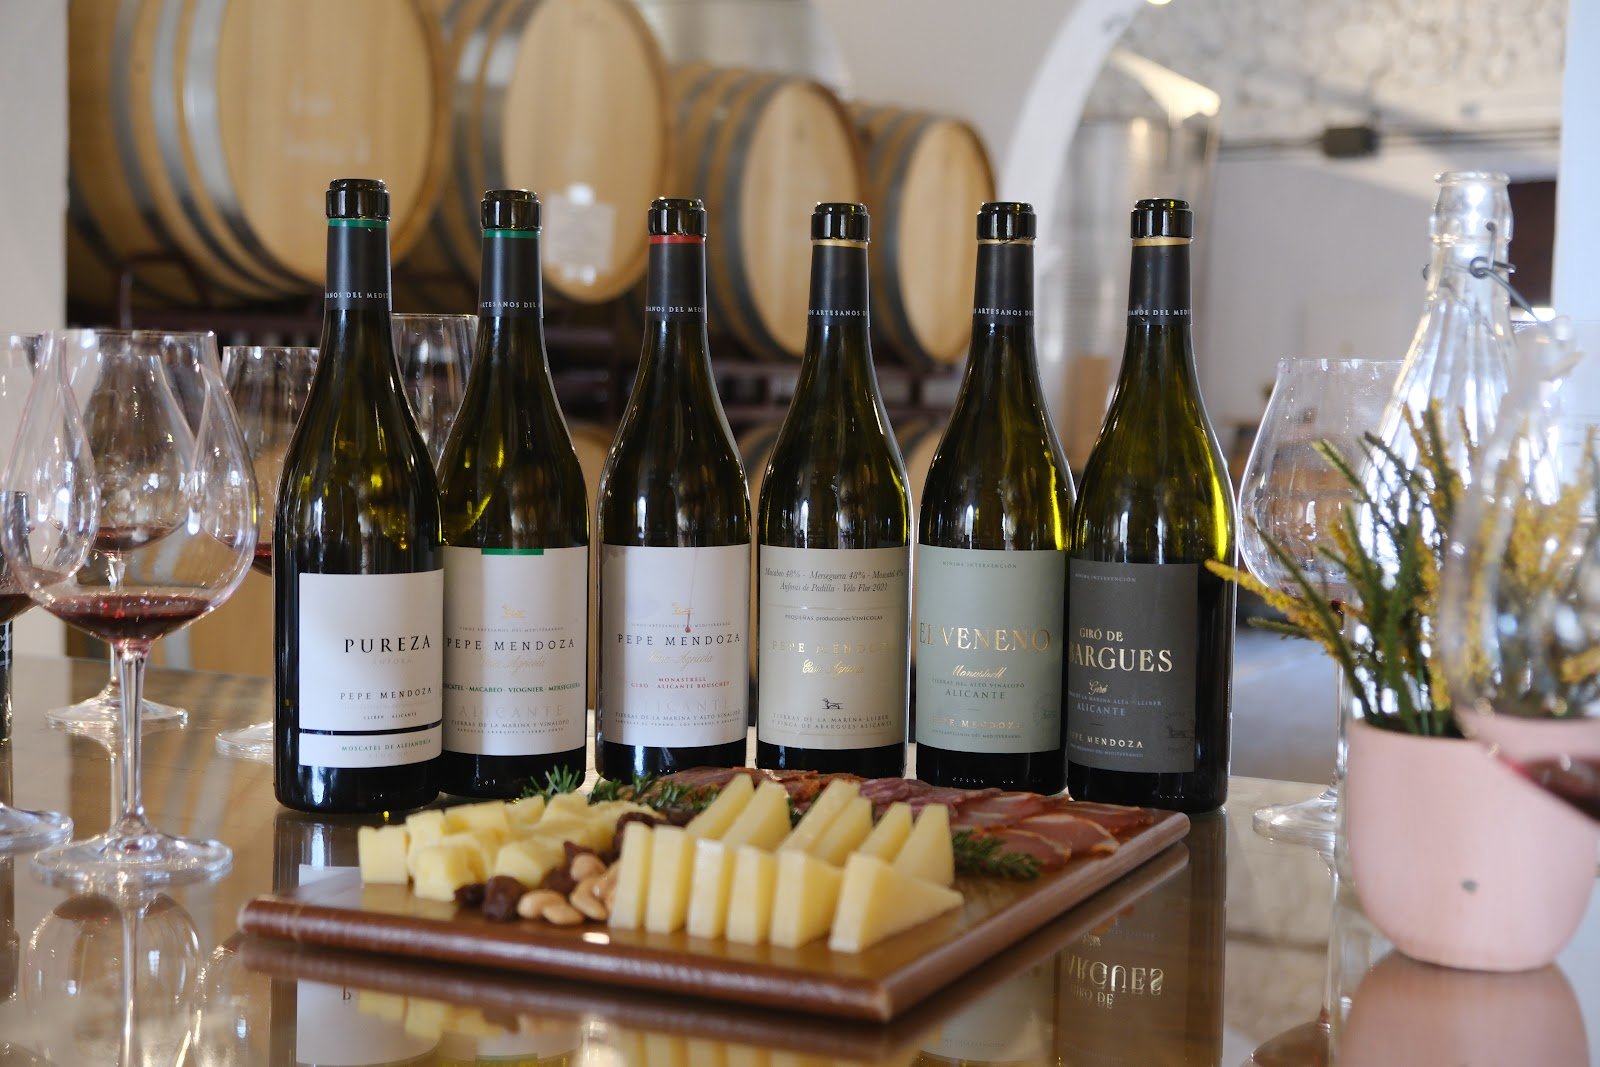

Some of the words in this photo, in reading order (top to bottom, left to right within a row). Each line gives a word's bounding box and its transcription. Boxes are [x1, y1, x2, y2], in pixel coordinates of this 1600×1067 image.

[815, 309, 861, 317] ARTESANOS
[977, 307, 1022, 316] ARTESANOS
[809, 570, 846, 581] Merseguera
[848, 571, 866, 580] 48%
[810, 583, 835, 592] Padilla
[617, 634, 654, 646] PEPE
[664, 633, 741, 647] MENDOZA
[919, 622, 935, 646] EL
[940, 625, 1051, 652] VENENO
[1079, 627, 1103, 641] GIRÓ
[1106, 630, 1124, 642] DE
[344, 634, 432, 654] PUREZA
[446, 637, 482, 650] PEPE
[494, 638, 575, 651] MENDOZA
[340, 692, 372, 701] PEPE
[380, 687, 433, 700] MENDOZA
[944, 688, 1006, 700] ALICANTE
[1076, 702, 1126, 717] ALICANTE
[341, 744, 381, 752] MOSCATEL
[1087, 735, 1144, 749] MENDOZA
